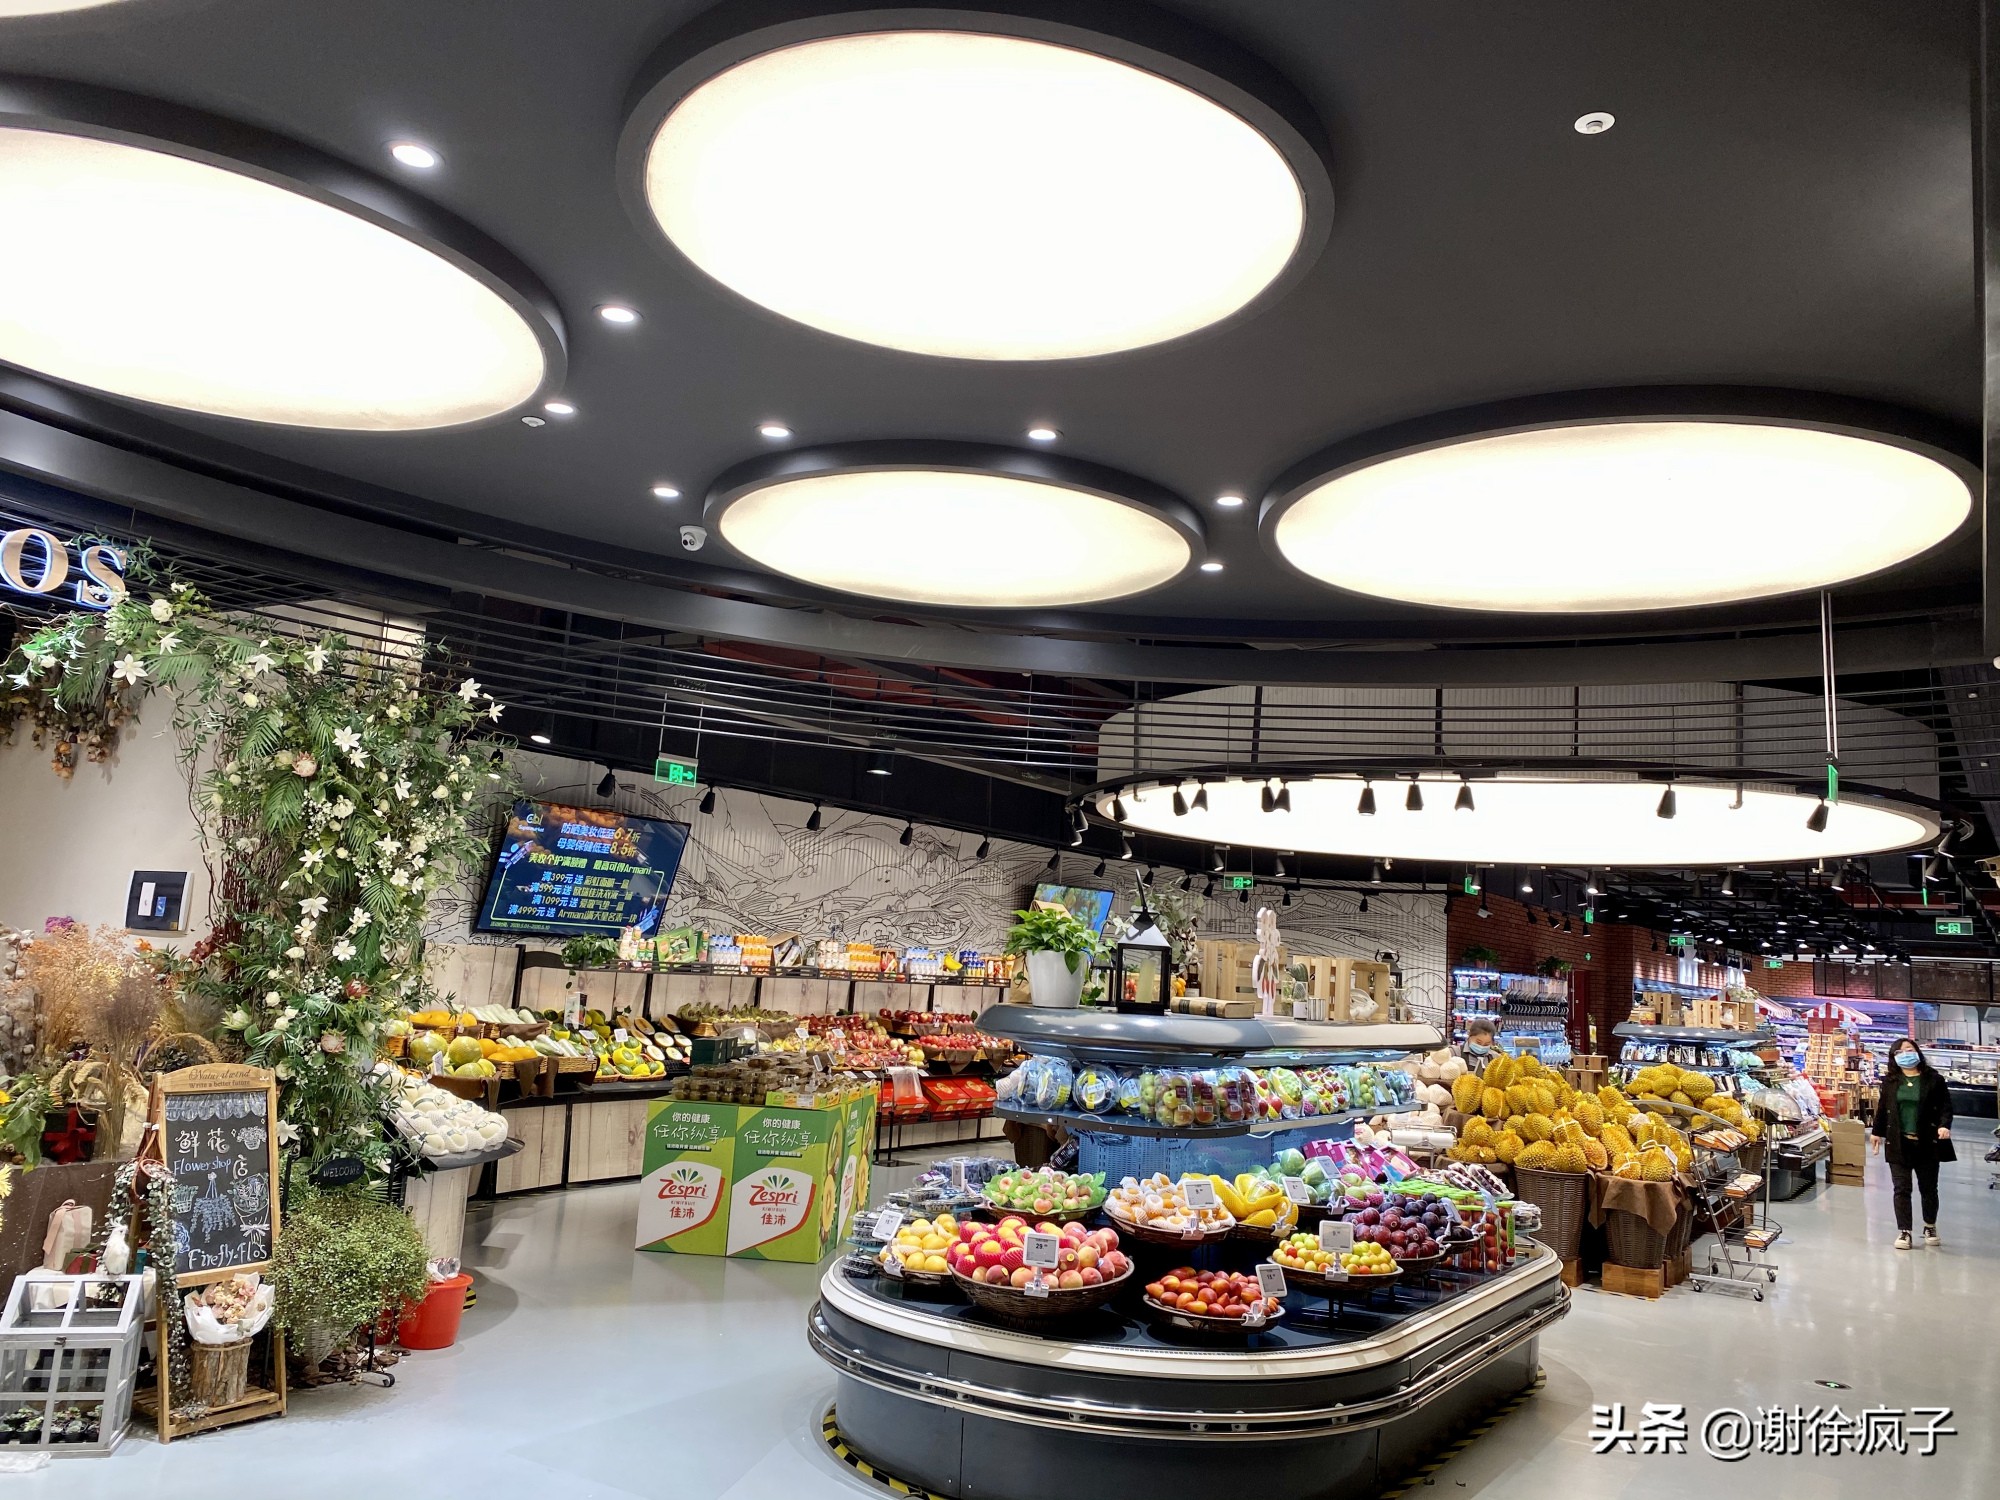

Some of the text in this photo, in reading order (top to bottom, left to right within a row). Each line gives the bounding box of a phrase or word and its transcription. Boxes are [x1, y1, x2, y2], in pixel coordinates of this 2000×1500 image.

[0, 527, 128, 609] OS
[556, 837, 638, 858] 母婴保健低至8.5折
[574, 874, 584, 885] 送
[562, 884, 573, 896] 送
[568, 896, 578, 908] 送
[547, 907, 557, 918] 送
[189, 1081, 208, 1089] Write
[671, 1111, 711, 1124] 你的健康
[762, 1117, 802, 1130] 你的健康
[174, 1127, 230, 1159] 鲜花
[173, 1155, 232, 1176] Flower shop
[233, 1154, 249, 1180] 店
[323, 1165, 361, 1178] WELCOME
[658, 1178, 708, 1200] Zespri
[749, 1184, 799, 1207] Zespri
[669, 1206, 695, 1220] 佳沛
[760, 1212, 786, 1226] 佳沛
